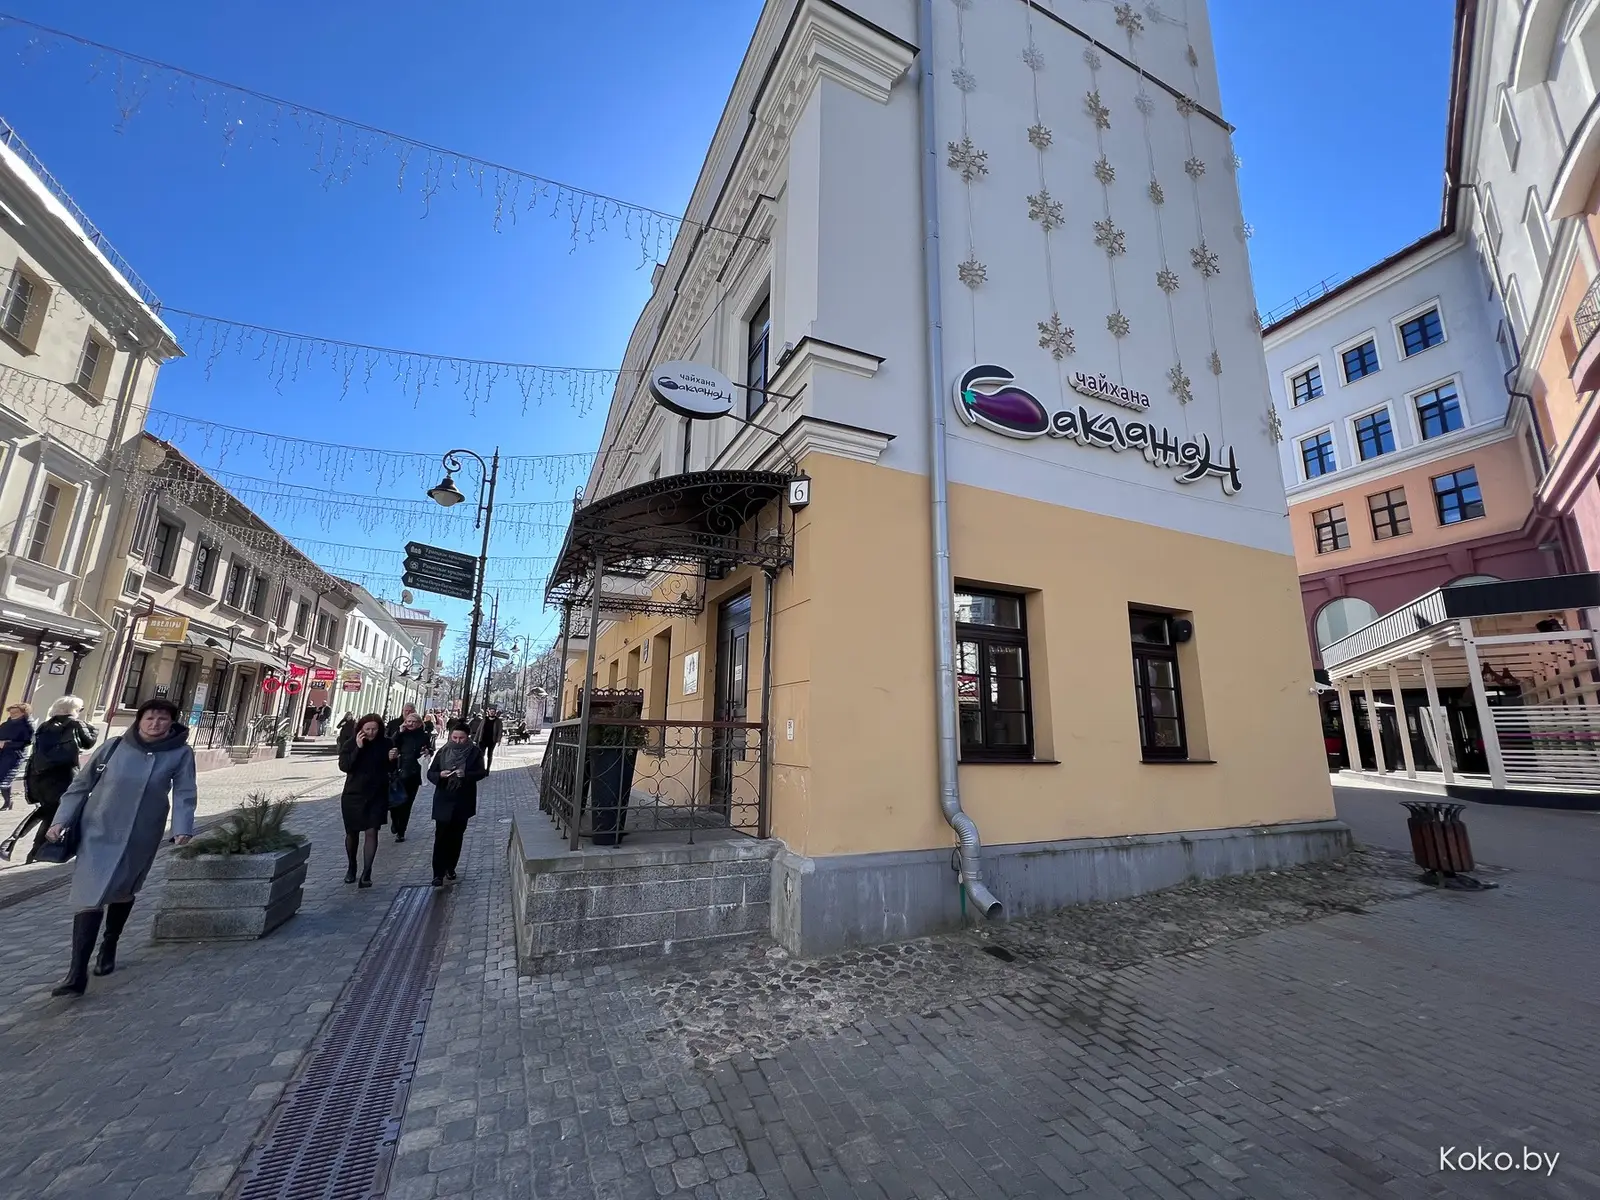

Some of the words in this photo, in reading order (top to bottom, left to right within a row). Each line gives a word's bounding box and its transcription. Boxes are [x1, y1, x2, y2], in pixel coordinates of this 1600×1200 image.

[680, 373, 716, 388] чайхана
[1075, 371, 1150, 407] чайхана
[794, 482, 804, 501] 6
[54, 665, 61, 673] 5
